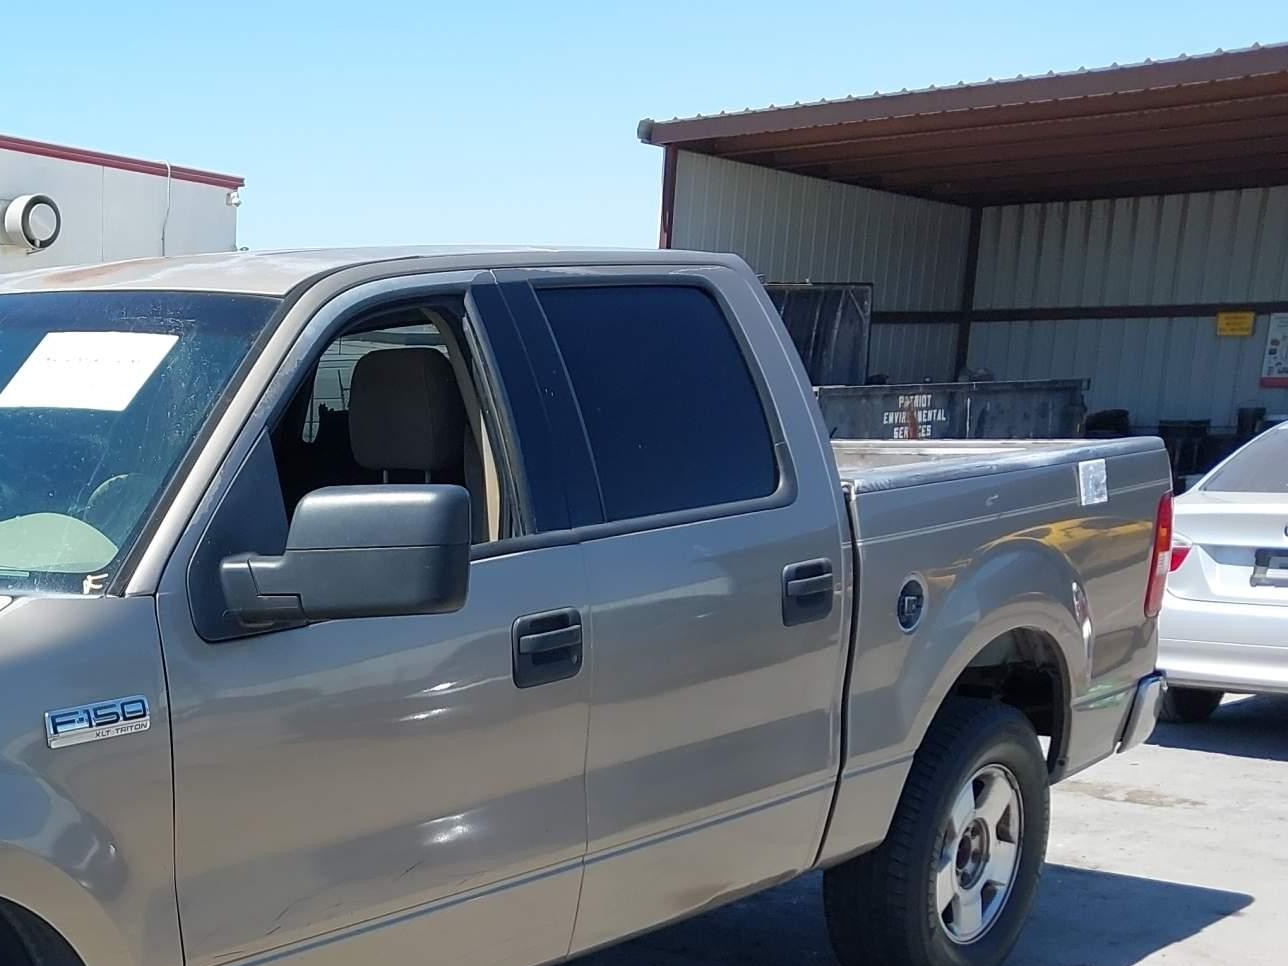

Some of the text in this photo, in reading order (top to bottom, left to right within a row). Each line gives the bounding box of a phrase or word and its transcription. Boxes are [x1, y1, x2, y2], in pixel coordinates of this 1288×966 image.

[898, 394, 932, 409] PATRIOT
[50, 699, 148, 735] F-150
[95, 722, 148, 738] XLT TRITON
